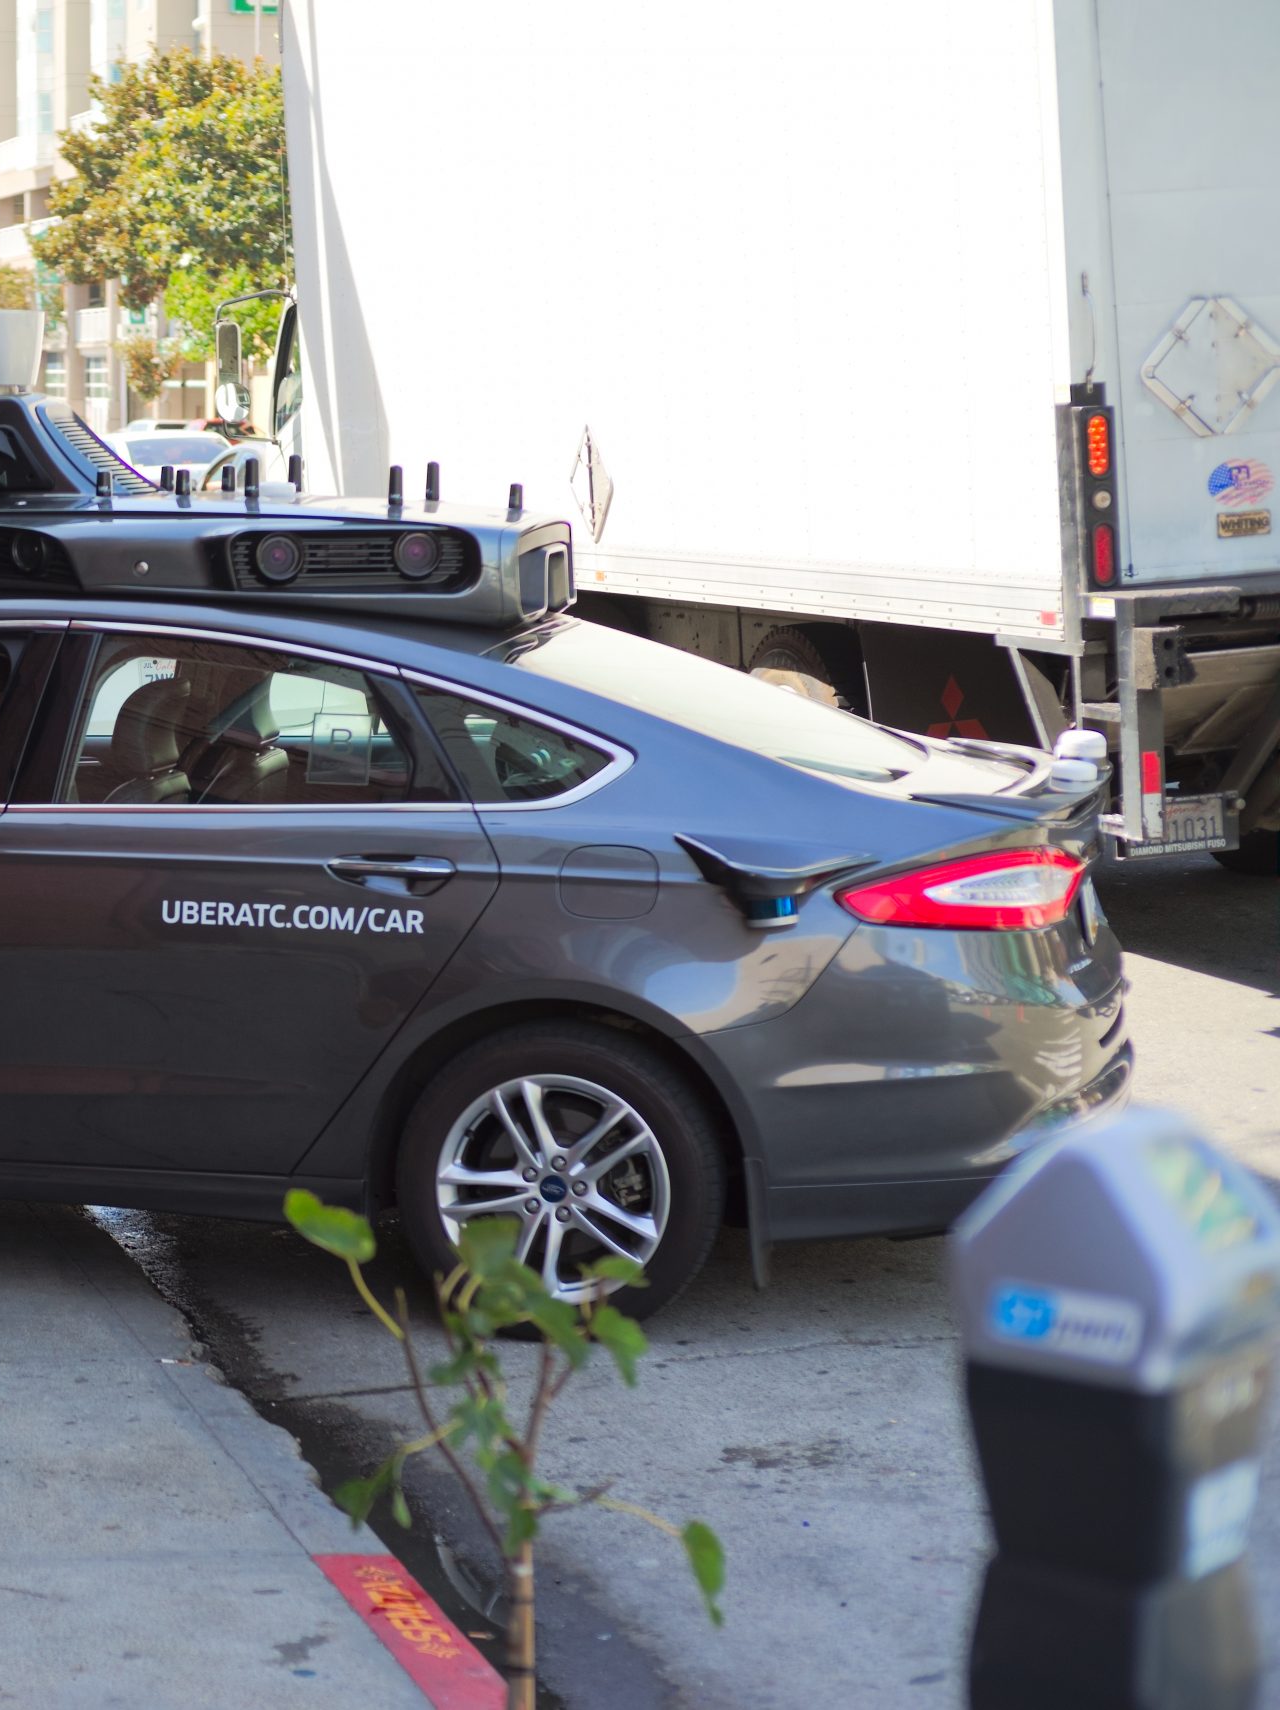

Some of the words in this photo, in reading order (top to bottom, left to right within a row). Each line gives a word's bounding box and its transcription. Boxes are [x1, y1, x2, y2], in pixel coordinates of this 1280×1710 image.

[1220, 516, 1270, 530] WHITING
[1171, 816, 1219, 842] 1031
[1130, 846, 1164, 857] DIAMOND
[1165, 841, 1206, 853] MITSUBISHI
[1207, 838, 1226, 848] FUSO
[161, 899, 425, 935] UBERATC.COM/CAR
